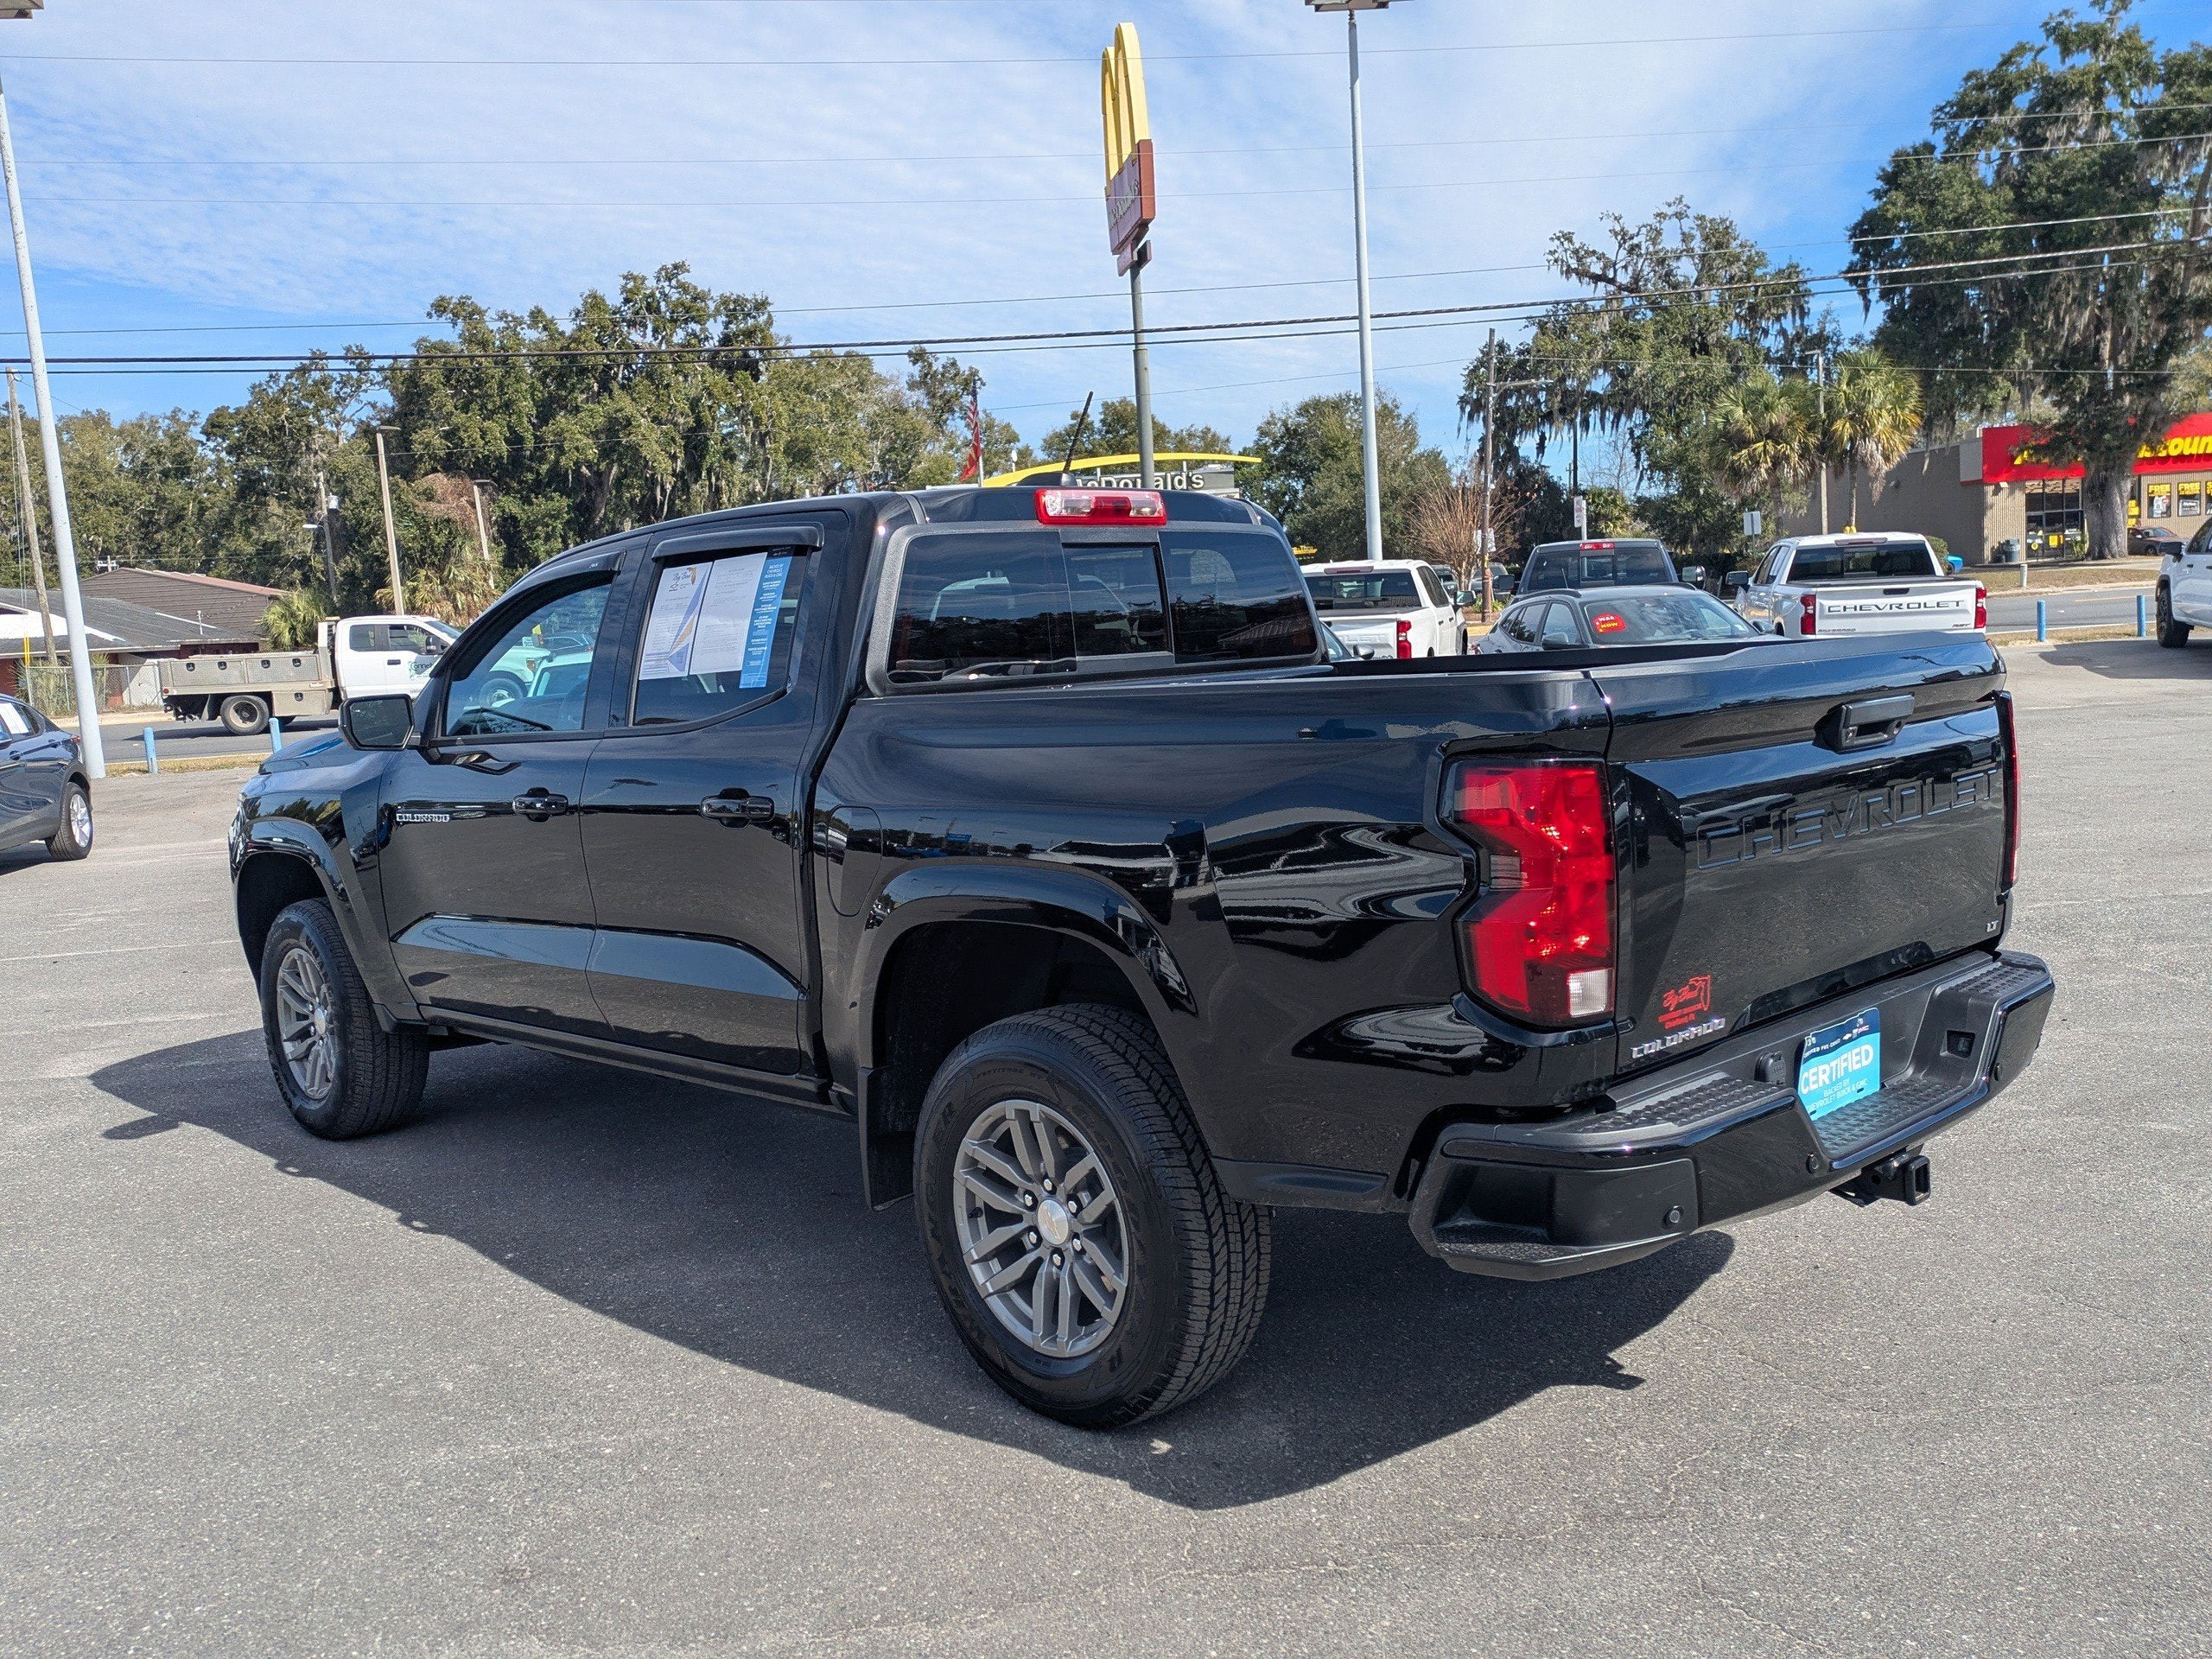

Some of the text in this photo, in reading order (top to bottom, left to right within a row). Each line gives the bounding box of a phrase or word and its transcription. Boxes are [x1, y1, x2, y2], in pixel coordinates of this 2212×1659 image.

[1077, 473, 1205, 490] cDoald's
[2178, 482, 2201, 491] FREE
[2149, 484, 2171, 493] FREE
[1827, 600, 1964, 613] CHEVROLET
[397, 813, 449, 822] COLORADO
[1696, 762, 2001, 869] CHEVROLET
[1986, 920, 1999, 932] LT
[1630, 1018, 1726, 1059] COLORADO
[1800, 1044, 1874, 1095] CERTIFIED
[1824, 1078, 1850, 1097] BACKED BY
[1856, 1078, 1868, 1089] GMC
